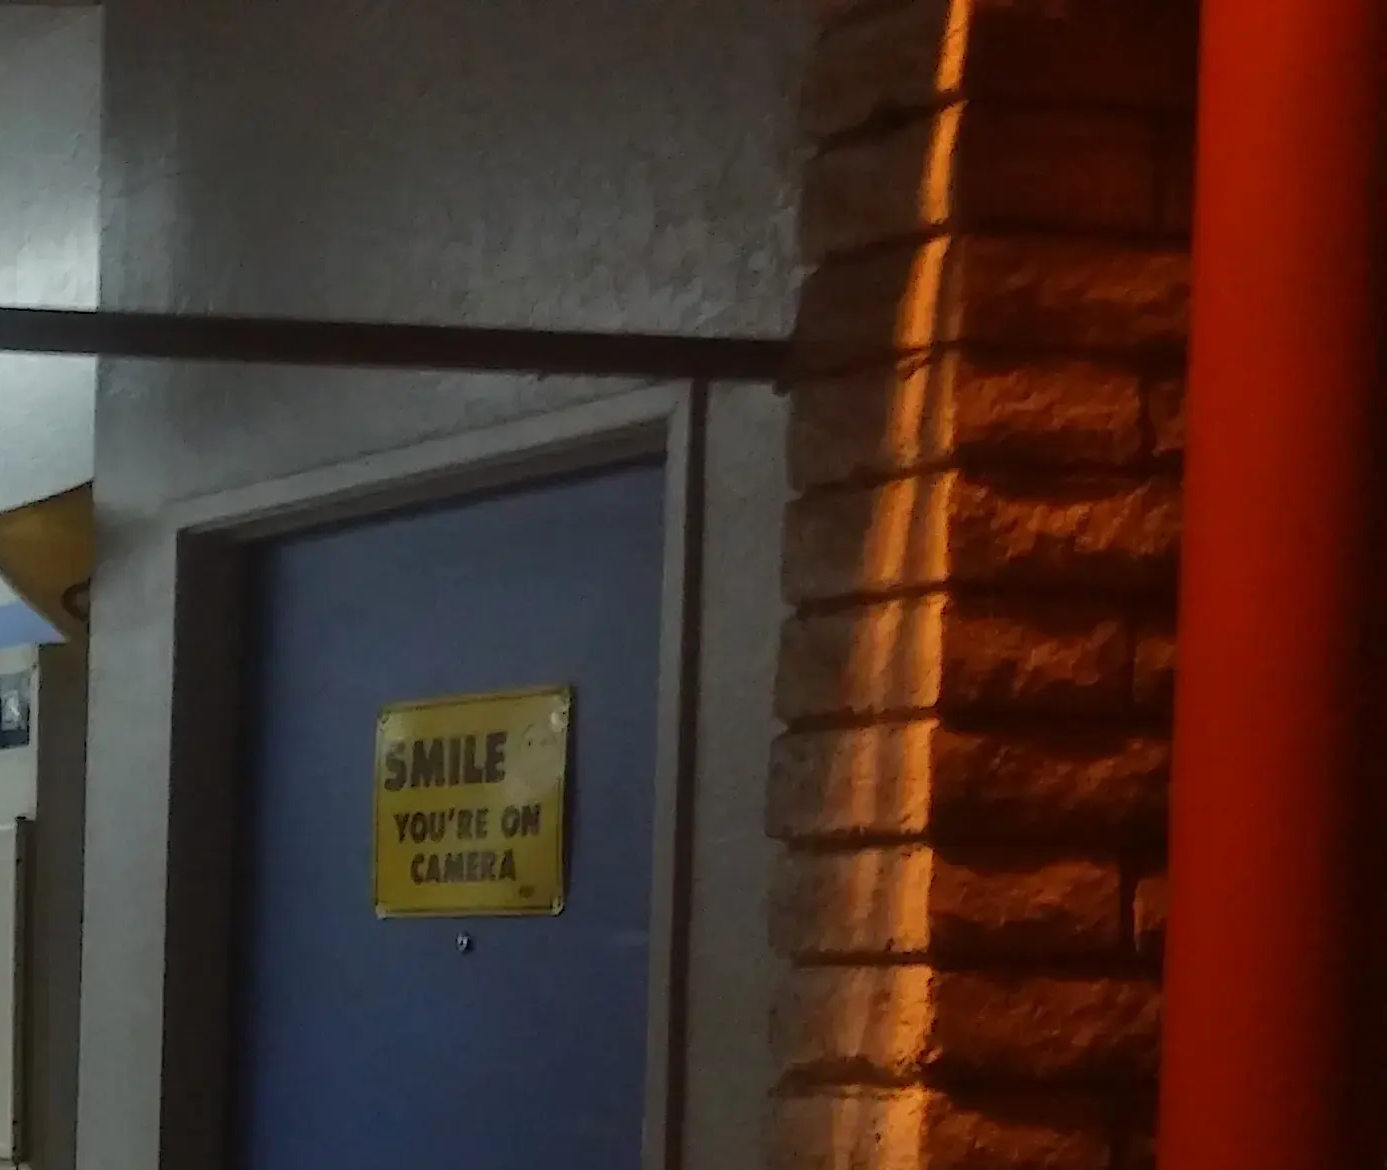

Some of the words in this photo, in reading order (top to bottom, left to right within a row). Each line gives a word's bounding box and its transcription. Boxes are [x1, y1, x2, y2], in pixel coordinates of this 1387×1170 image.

[383, 731, 508, 792] SMILE
[393, 807, 490, 844] YOU'RE
[500, 803, 542, 840] ON
[410, 849, 517, 885] CAMERA
